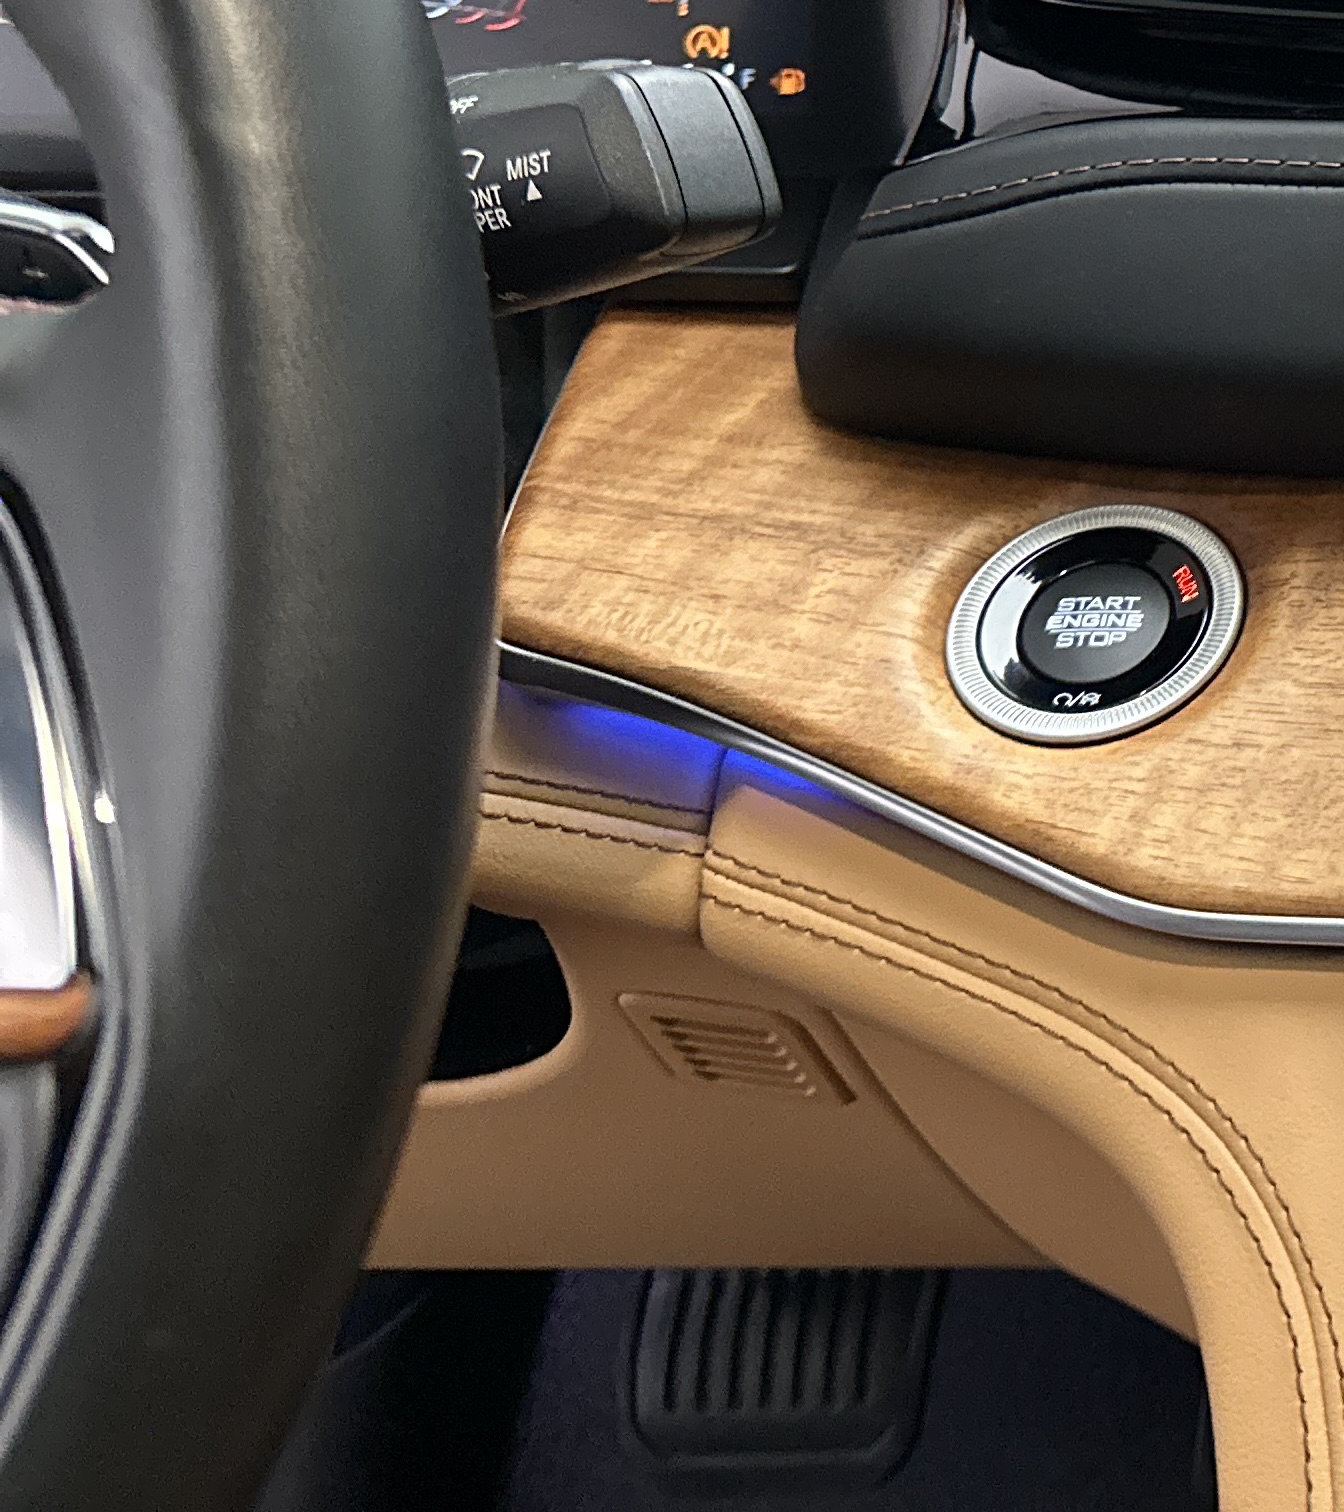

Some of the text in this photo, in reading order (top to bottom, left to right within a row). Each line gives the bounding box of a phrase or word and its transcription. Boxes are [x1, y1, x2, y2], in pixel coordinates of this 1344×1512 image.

[505, 149, 552, 181] MIST
[1172, 564, 1200, 603] RUN
[1058, 596, 1141, 611] START
[1045, 614, 1145, 629] ENGINE
[1054, 632, 1127, 648] STOP
